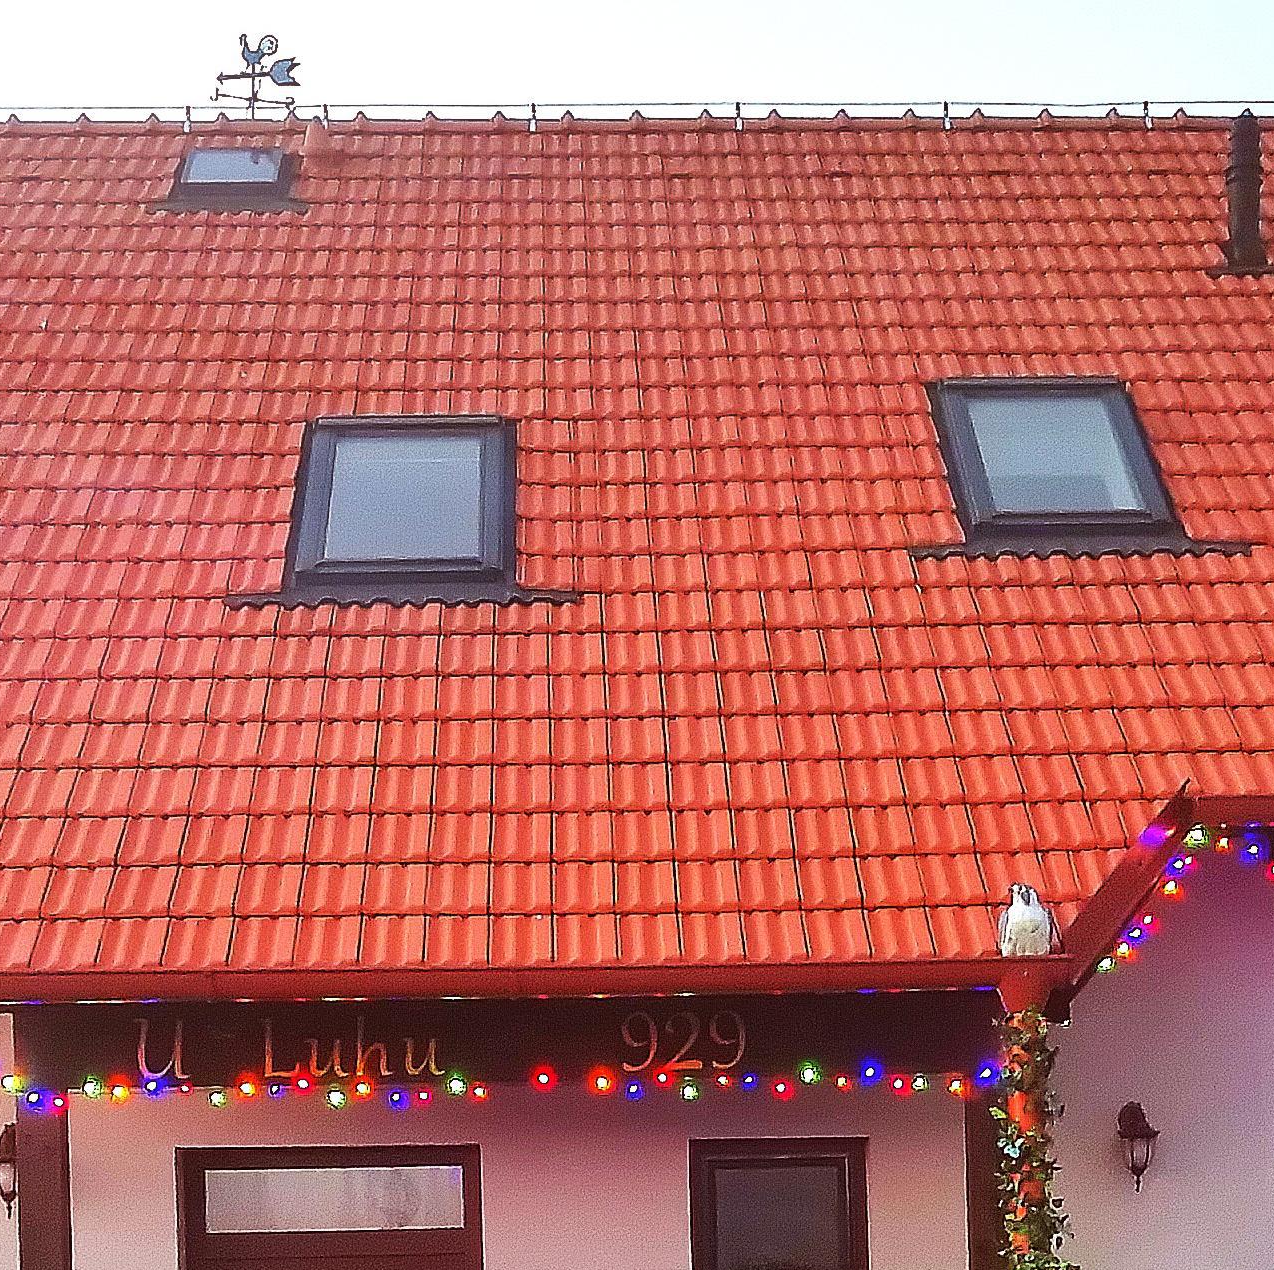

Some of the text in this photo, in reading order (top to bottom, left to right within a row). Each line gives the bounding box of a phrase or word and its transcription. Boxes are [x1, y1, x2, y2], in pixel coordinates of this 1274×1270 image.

[134, 1010, 745, 1079] U Luhu 929
